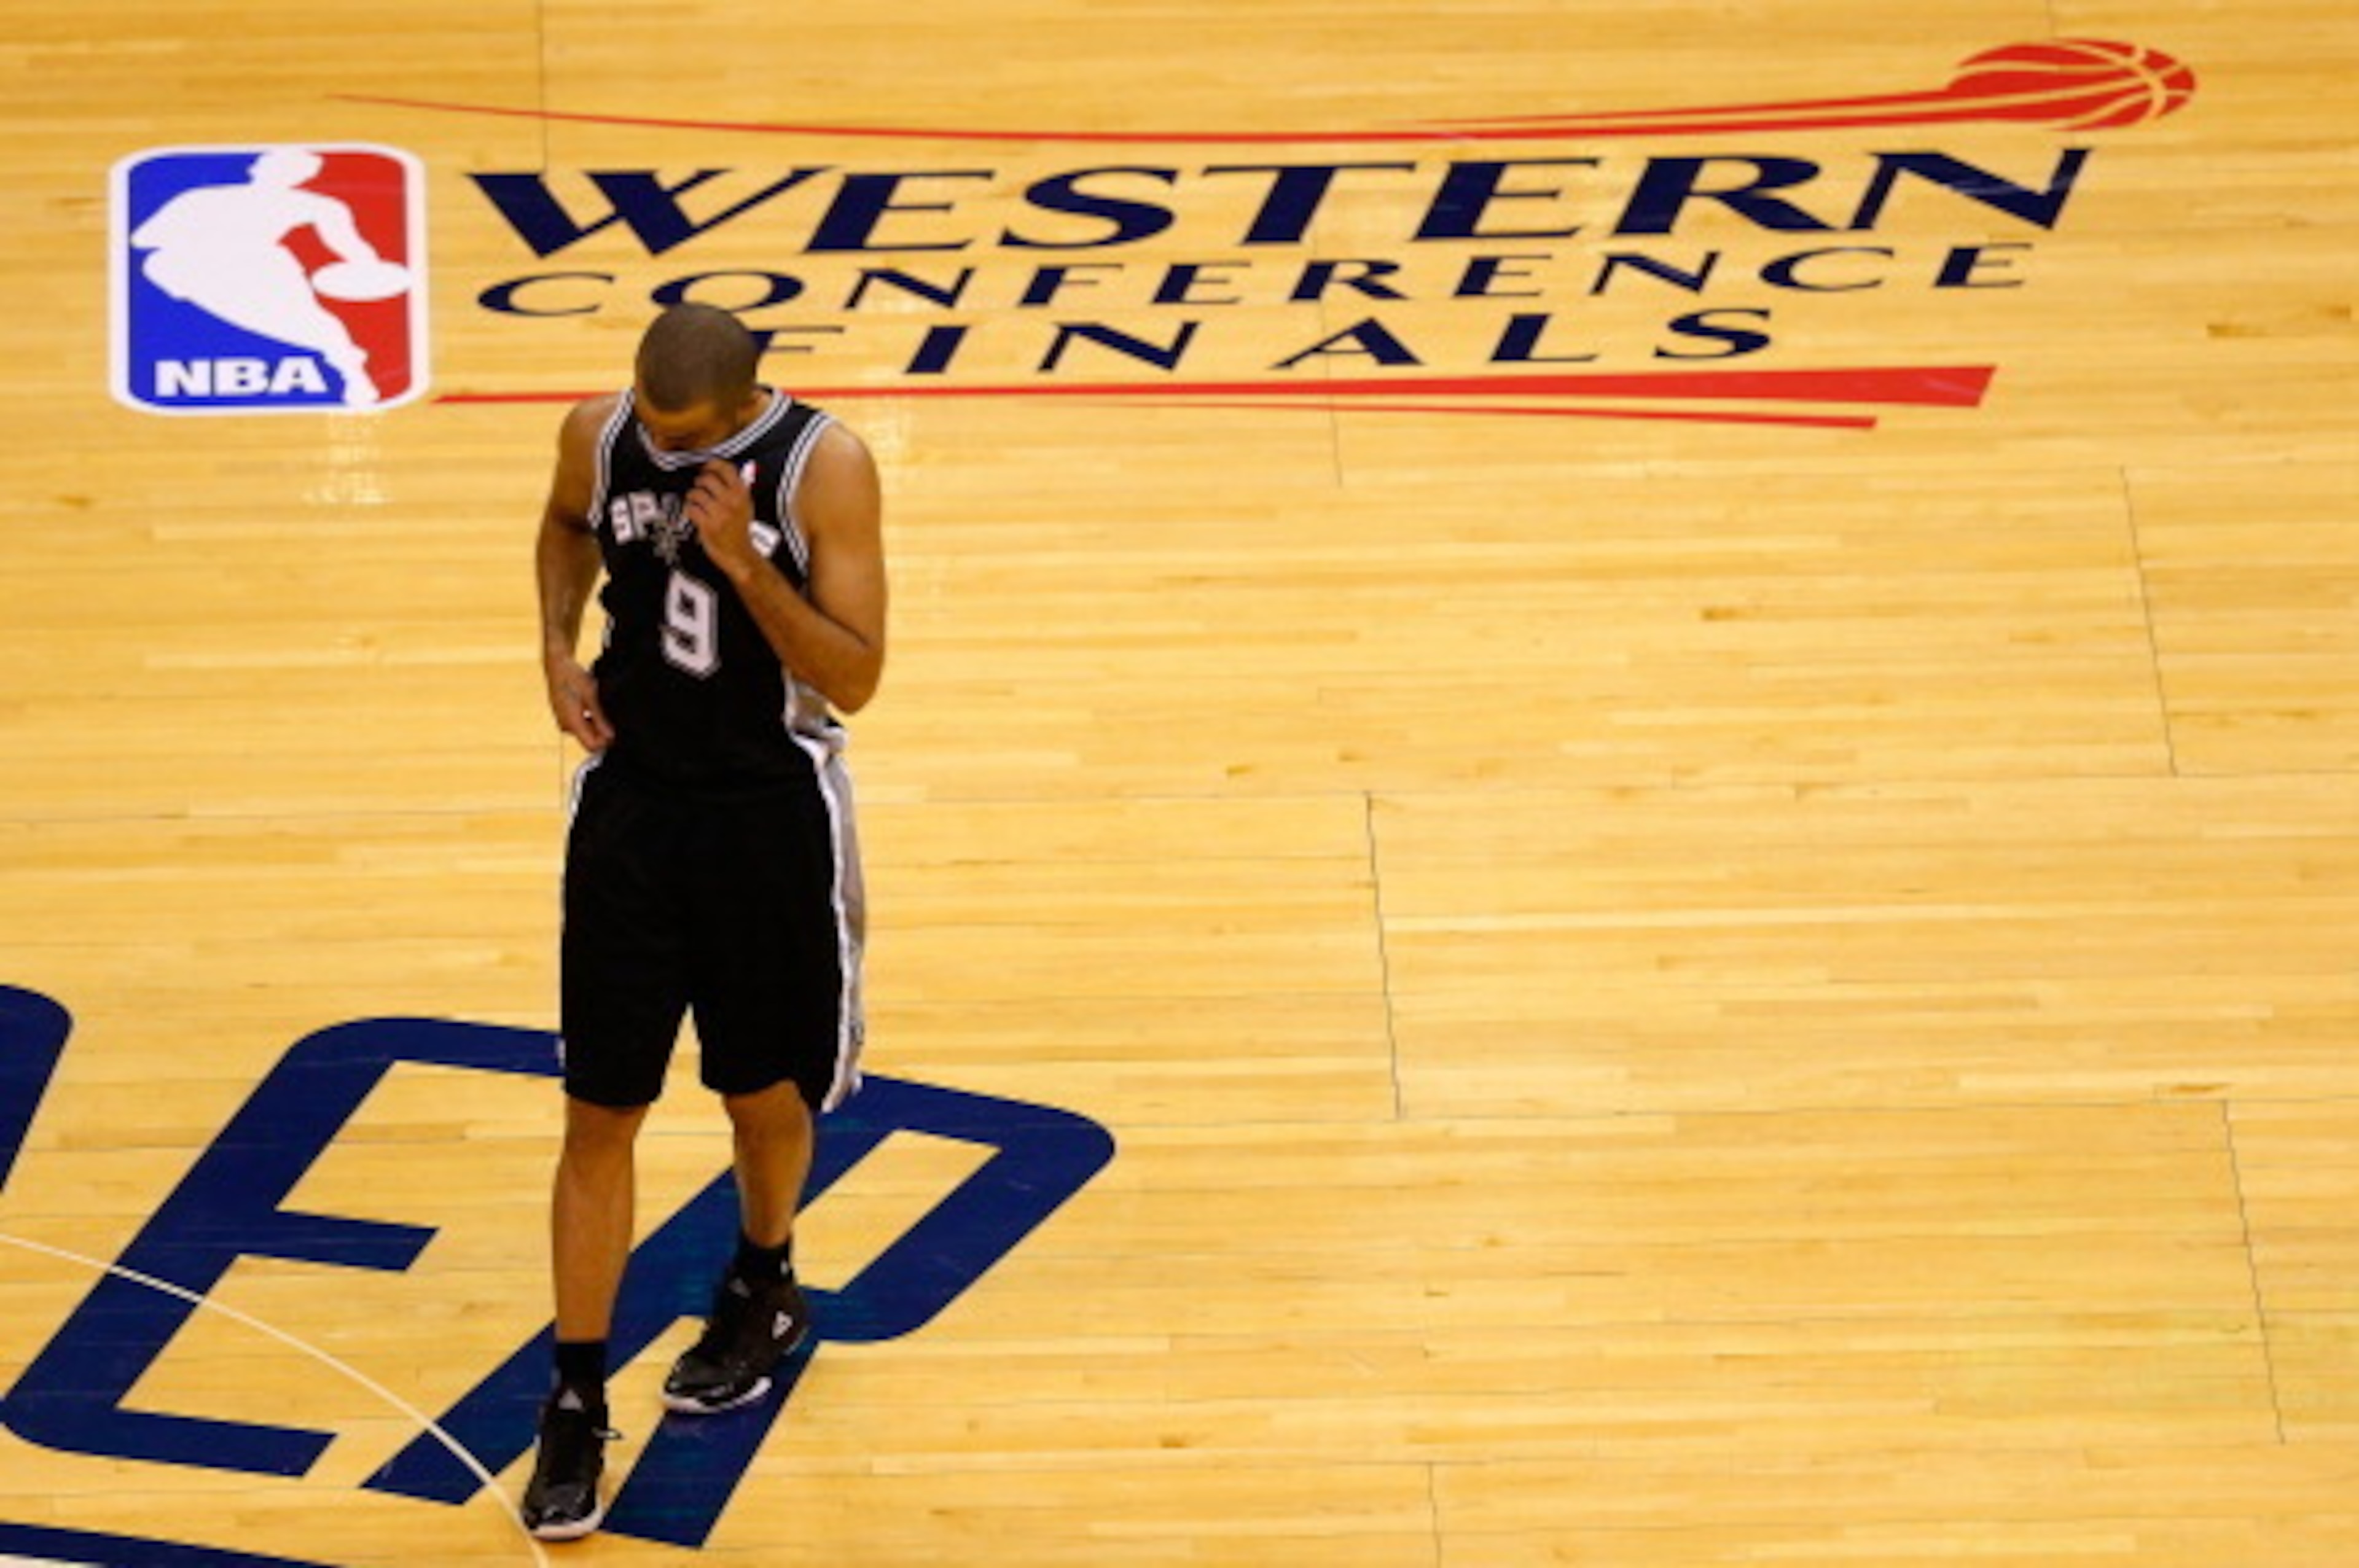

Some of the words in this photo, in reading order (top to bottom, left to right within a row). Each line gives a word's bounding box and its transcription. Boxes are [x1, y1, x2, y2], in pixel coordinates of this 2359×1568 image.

[466, 147, 2092, 259] WESTERN
[477, 243, 2034, 316] CONFERENCE
[155, 357, 327, 397] NBA
[660, 569, 721, 681] 9
